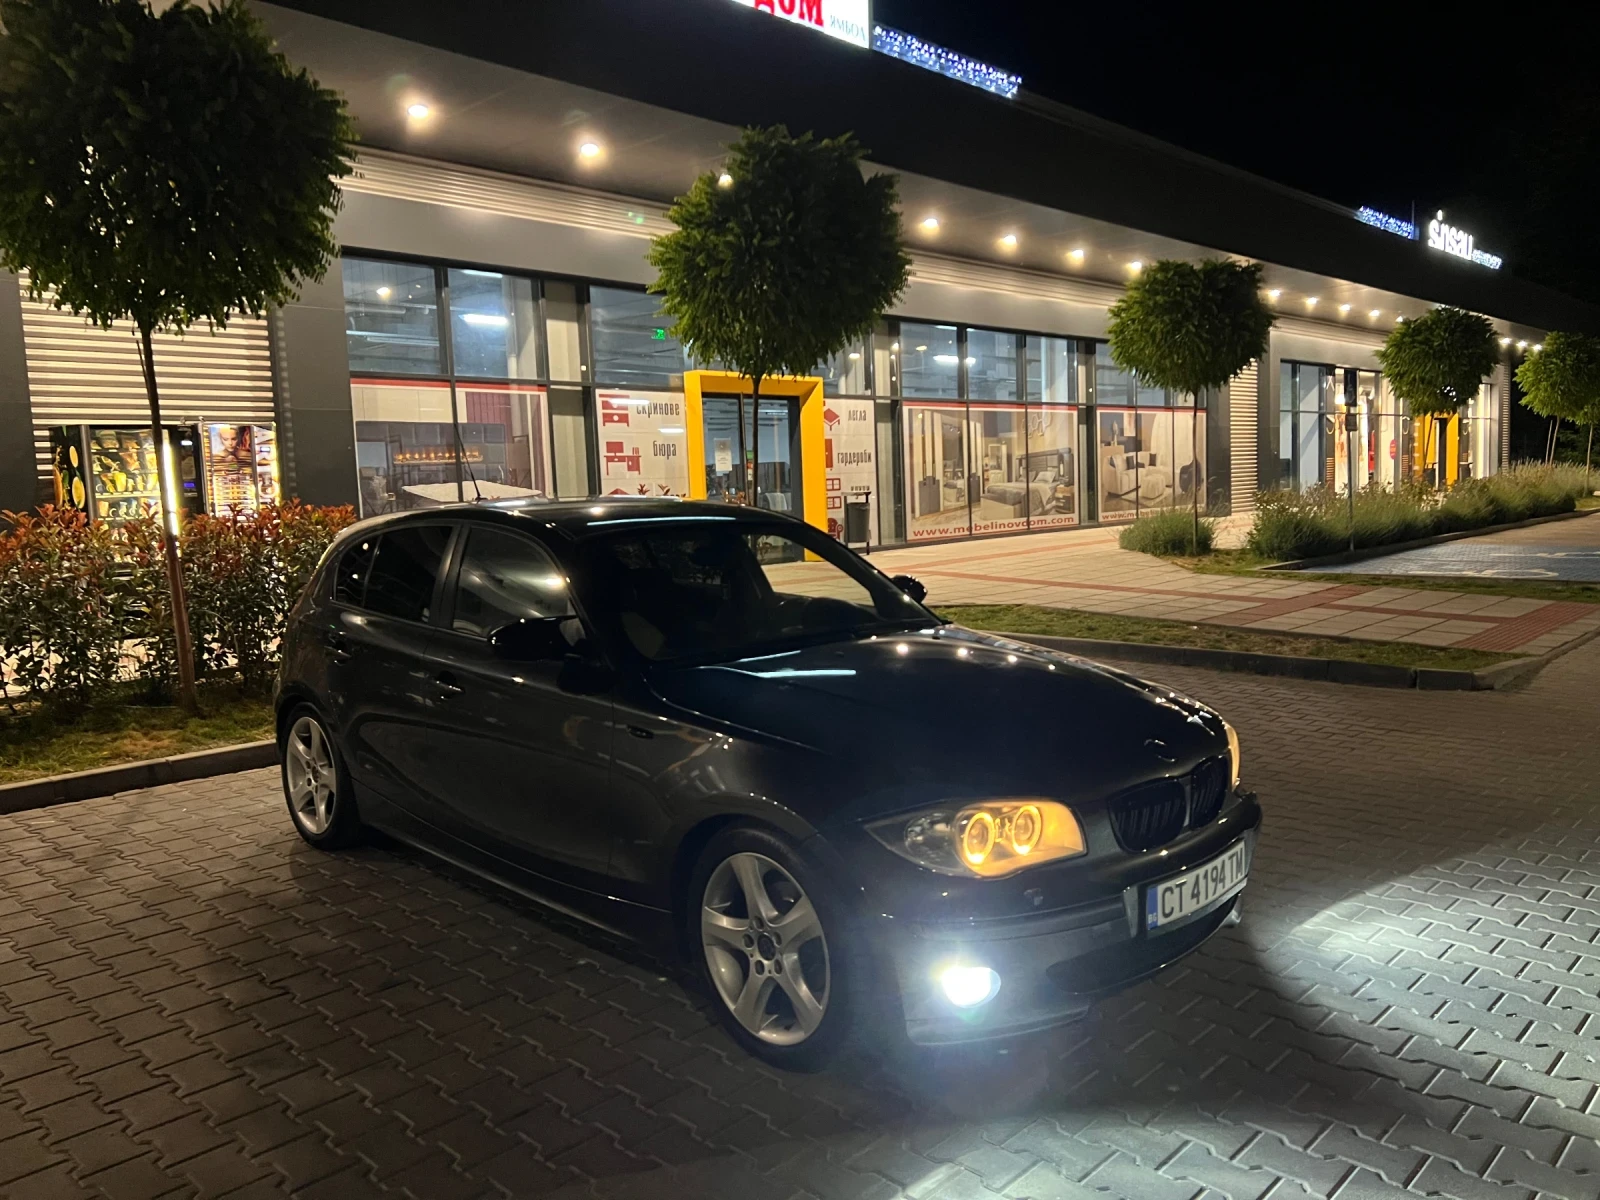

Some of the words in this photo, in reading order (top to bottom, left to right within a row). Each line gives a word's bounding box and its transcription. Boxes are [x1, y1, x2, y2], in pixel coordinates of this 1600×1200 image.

[830, 15, 866, 41] ЯМБОЛ
[636, 402, 680, 418] скринове
[848, 409, 867, 421] легла
[653, 440, 677, 460] бюра
[837, 449, 872, 466] гардероби
[1162, 880, 1187, 919] CT
[1190, 860, 1226, 905] 4194
[1228, 848, 1243, 884] TM
[1148, 912, 1158, 924] BG
